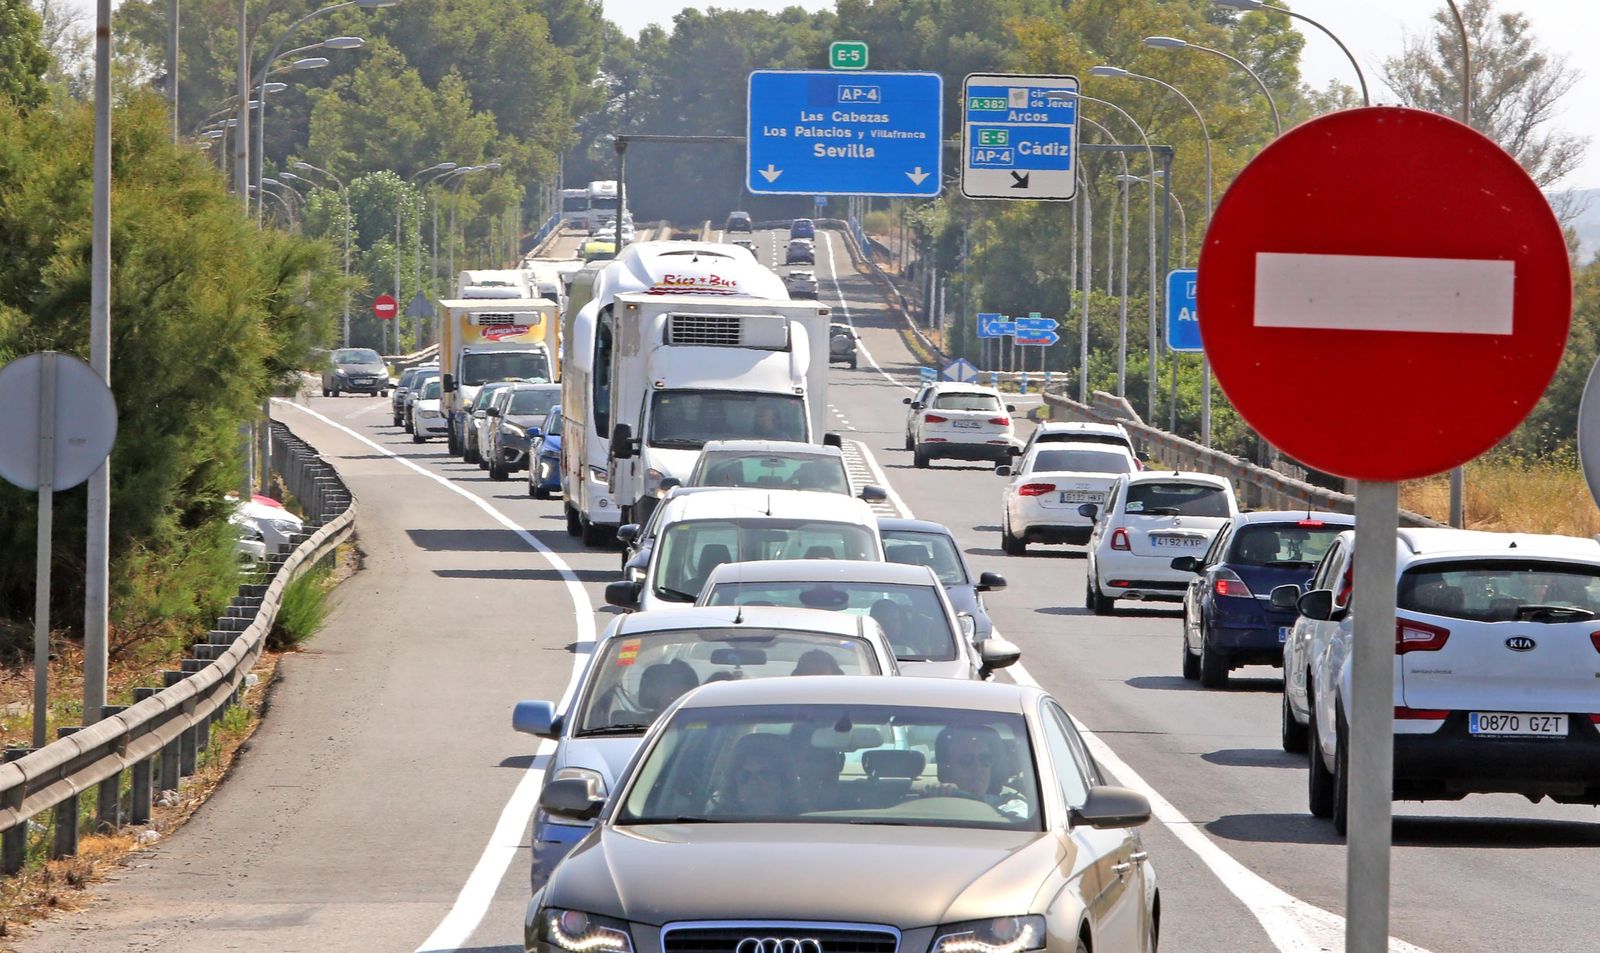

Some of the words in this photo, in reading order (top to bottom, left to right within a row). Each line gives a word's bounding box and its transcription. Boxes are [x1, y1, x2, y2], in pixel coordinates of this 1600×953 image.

[837, 50, 860, 61] E-5
[841, 88, 877, 100] AP-4
[971, 99, 1005, 109] A-382
[1031, 100, 1044, 108] de
[800, 111, 824, 122] Las
[832, 111, 889, 123] Cabezas
[1007, 110, 1048, 121] Arcos
[763, 126, 787, 137] Los
[795, 126, 852, 138] Palacios
[858, 131, 865, 140] y
[870, 129, 926, 139] Villafranca
[981, 132, 1006, 143] E-5
[814, 143, 875, 158] Sevilla
[1018, 141, 1068, 156] Cádiz
[976, 150, 1011, 162] AP-4
[709, 274, 737, 287] Bus
[1157, 538, 1180, 547] 4192
[1510, 639, 1531, 648] KIA
[1479, 715, 1519, 731] 0870
[1529, 716, 1562, 732] GZT
